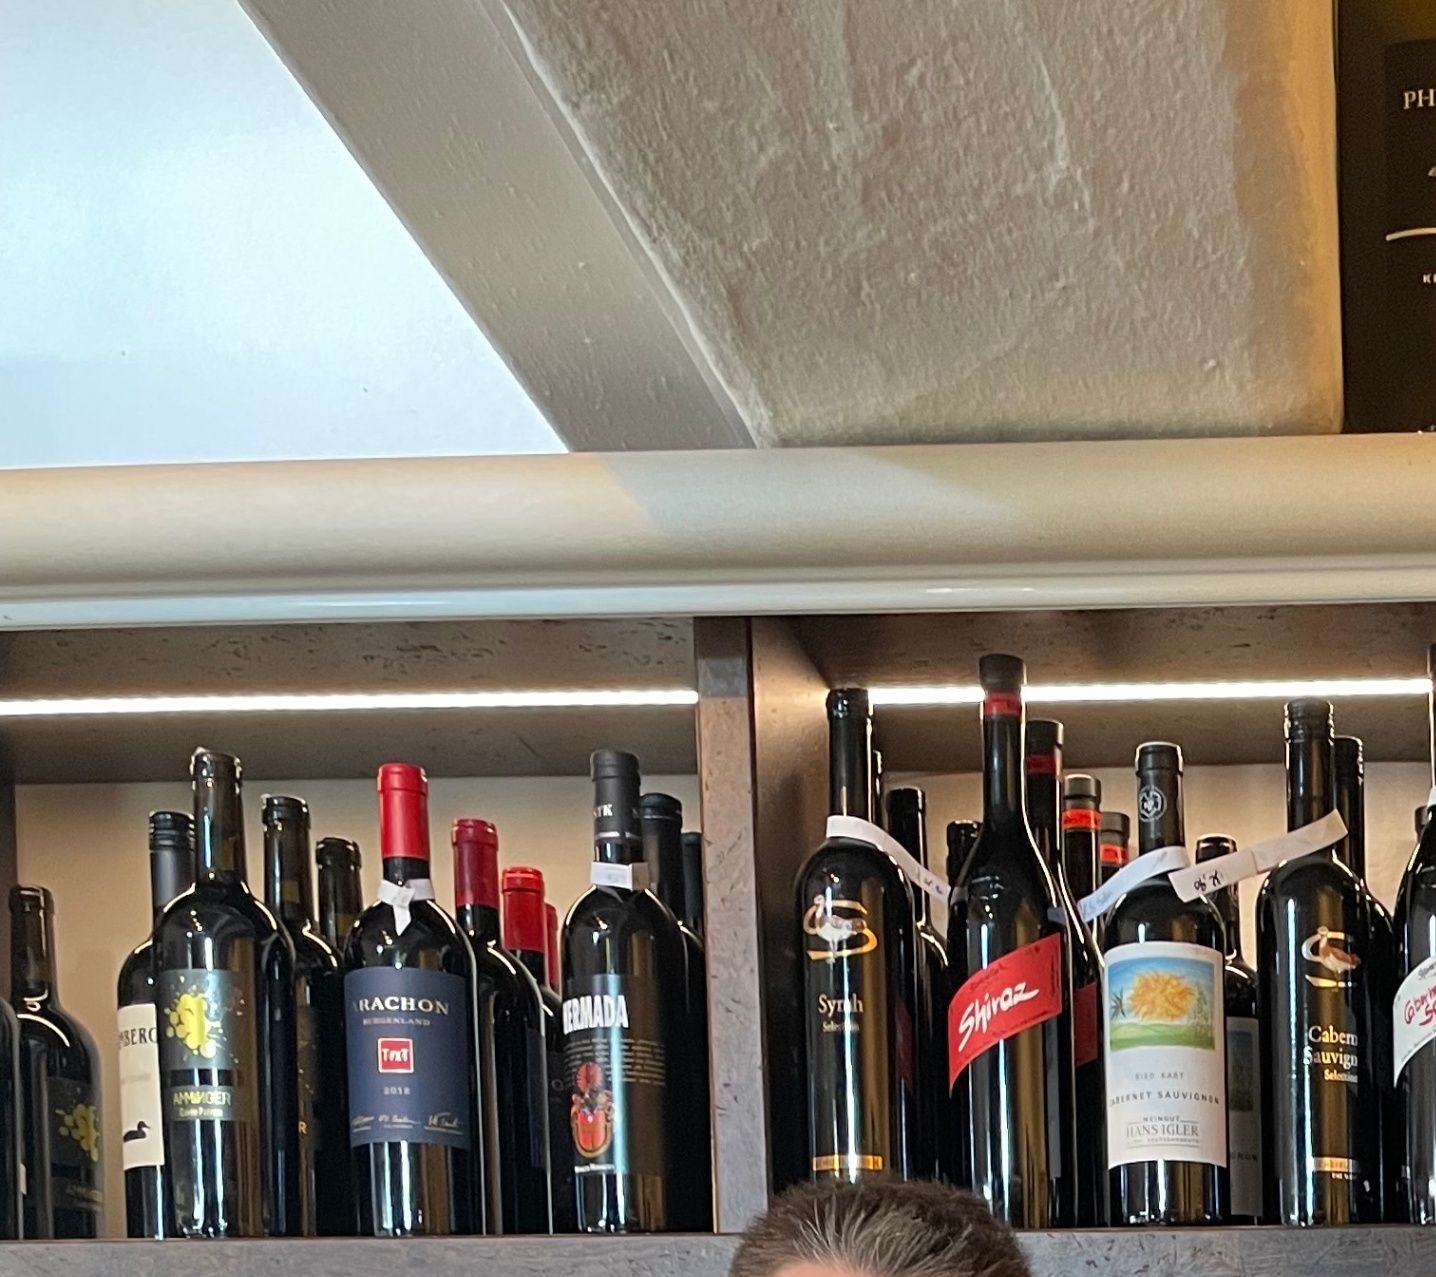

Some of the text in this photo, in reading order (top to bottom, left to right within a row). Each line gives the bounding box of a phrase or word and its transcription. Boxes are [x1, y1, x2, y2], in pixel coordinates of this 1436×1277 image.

[959, 982, 1039, 1053] Shiraz
[1157, 1090, 1220, 1105] SAUVIGNON
[1126, 1122, 1199, 1138] HANS IGLER
